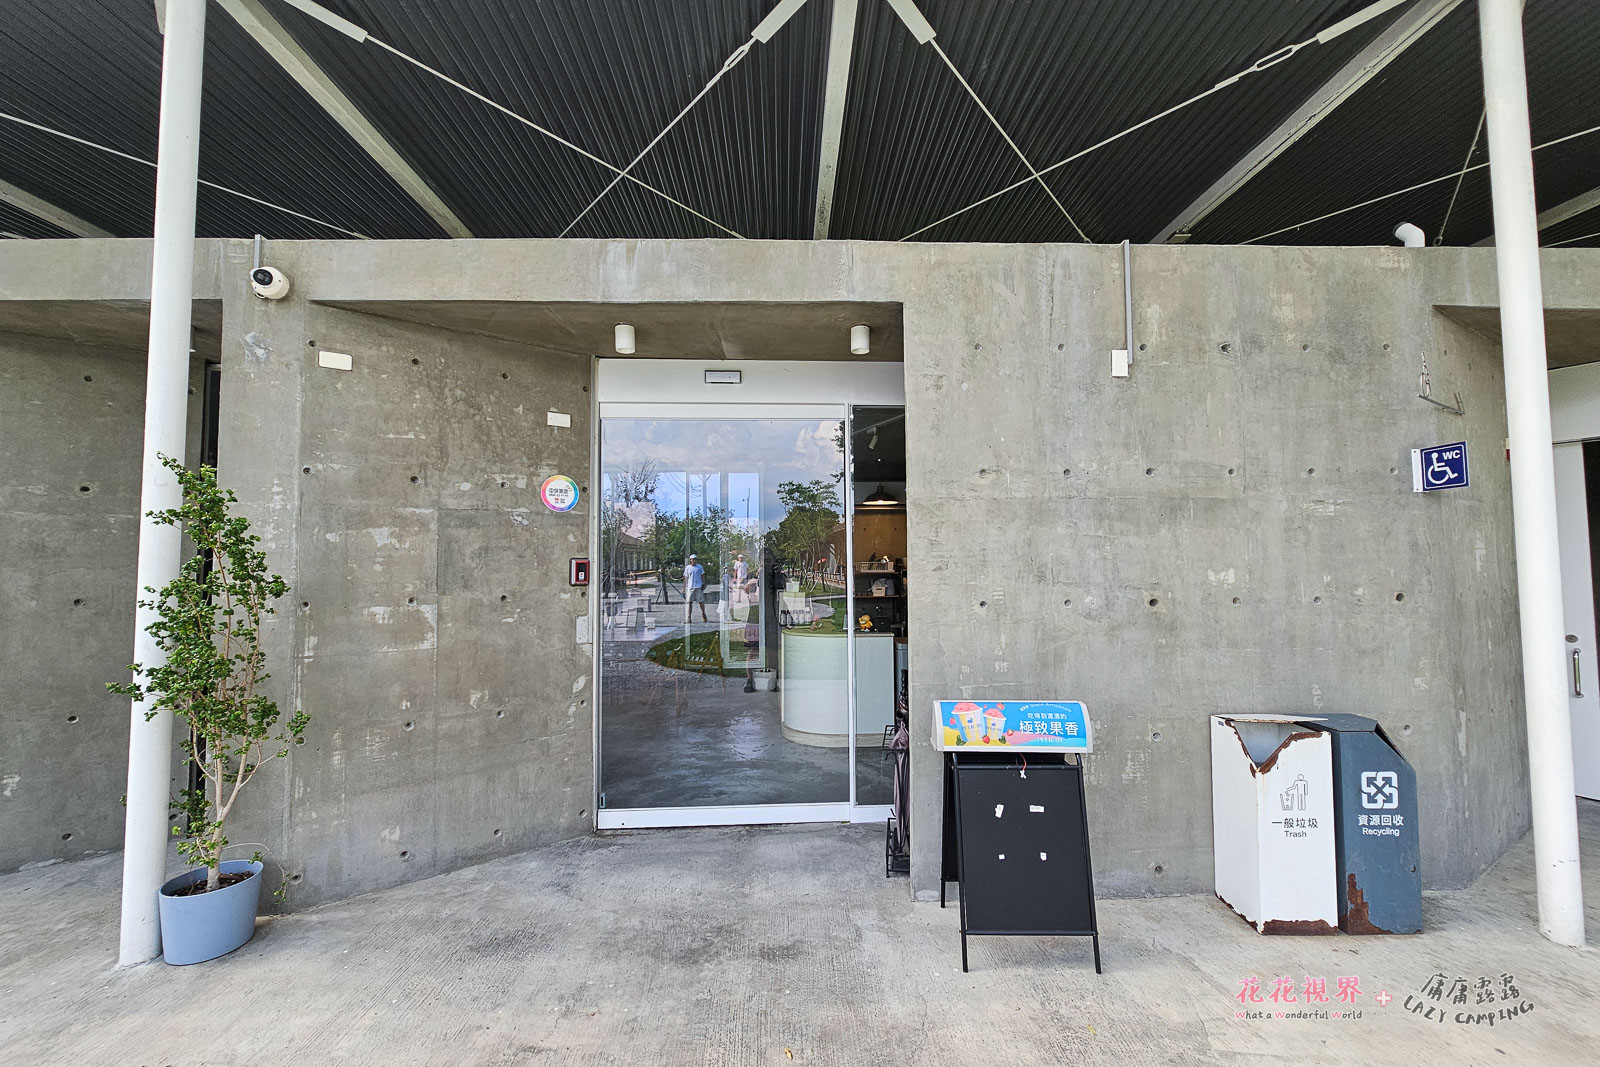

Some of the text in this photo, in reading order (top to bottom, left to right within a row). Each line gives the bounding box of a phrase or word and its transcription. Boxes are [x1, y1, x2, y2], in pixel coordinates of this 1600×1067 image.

[1442, 450, 1460, 460] WC
[1019, 720, 1079, 736] 極致果香
[1271, 817, 1319, 829] 一般垃圾
[1357, 814, 1404, 826] 資源回收
[1284, 830, 1307, 838] Trash
[1362, 827, 1400, 836] Recycling
